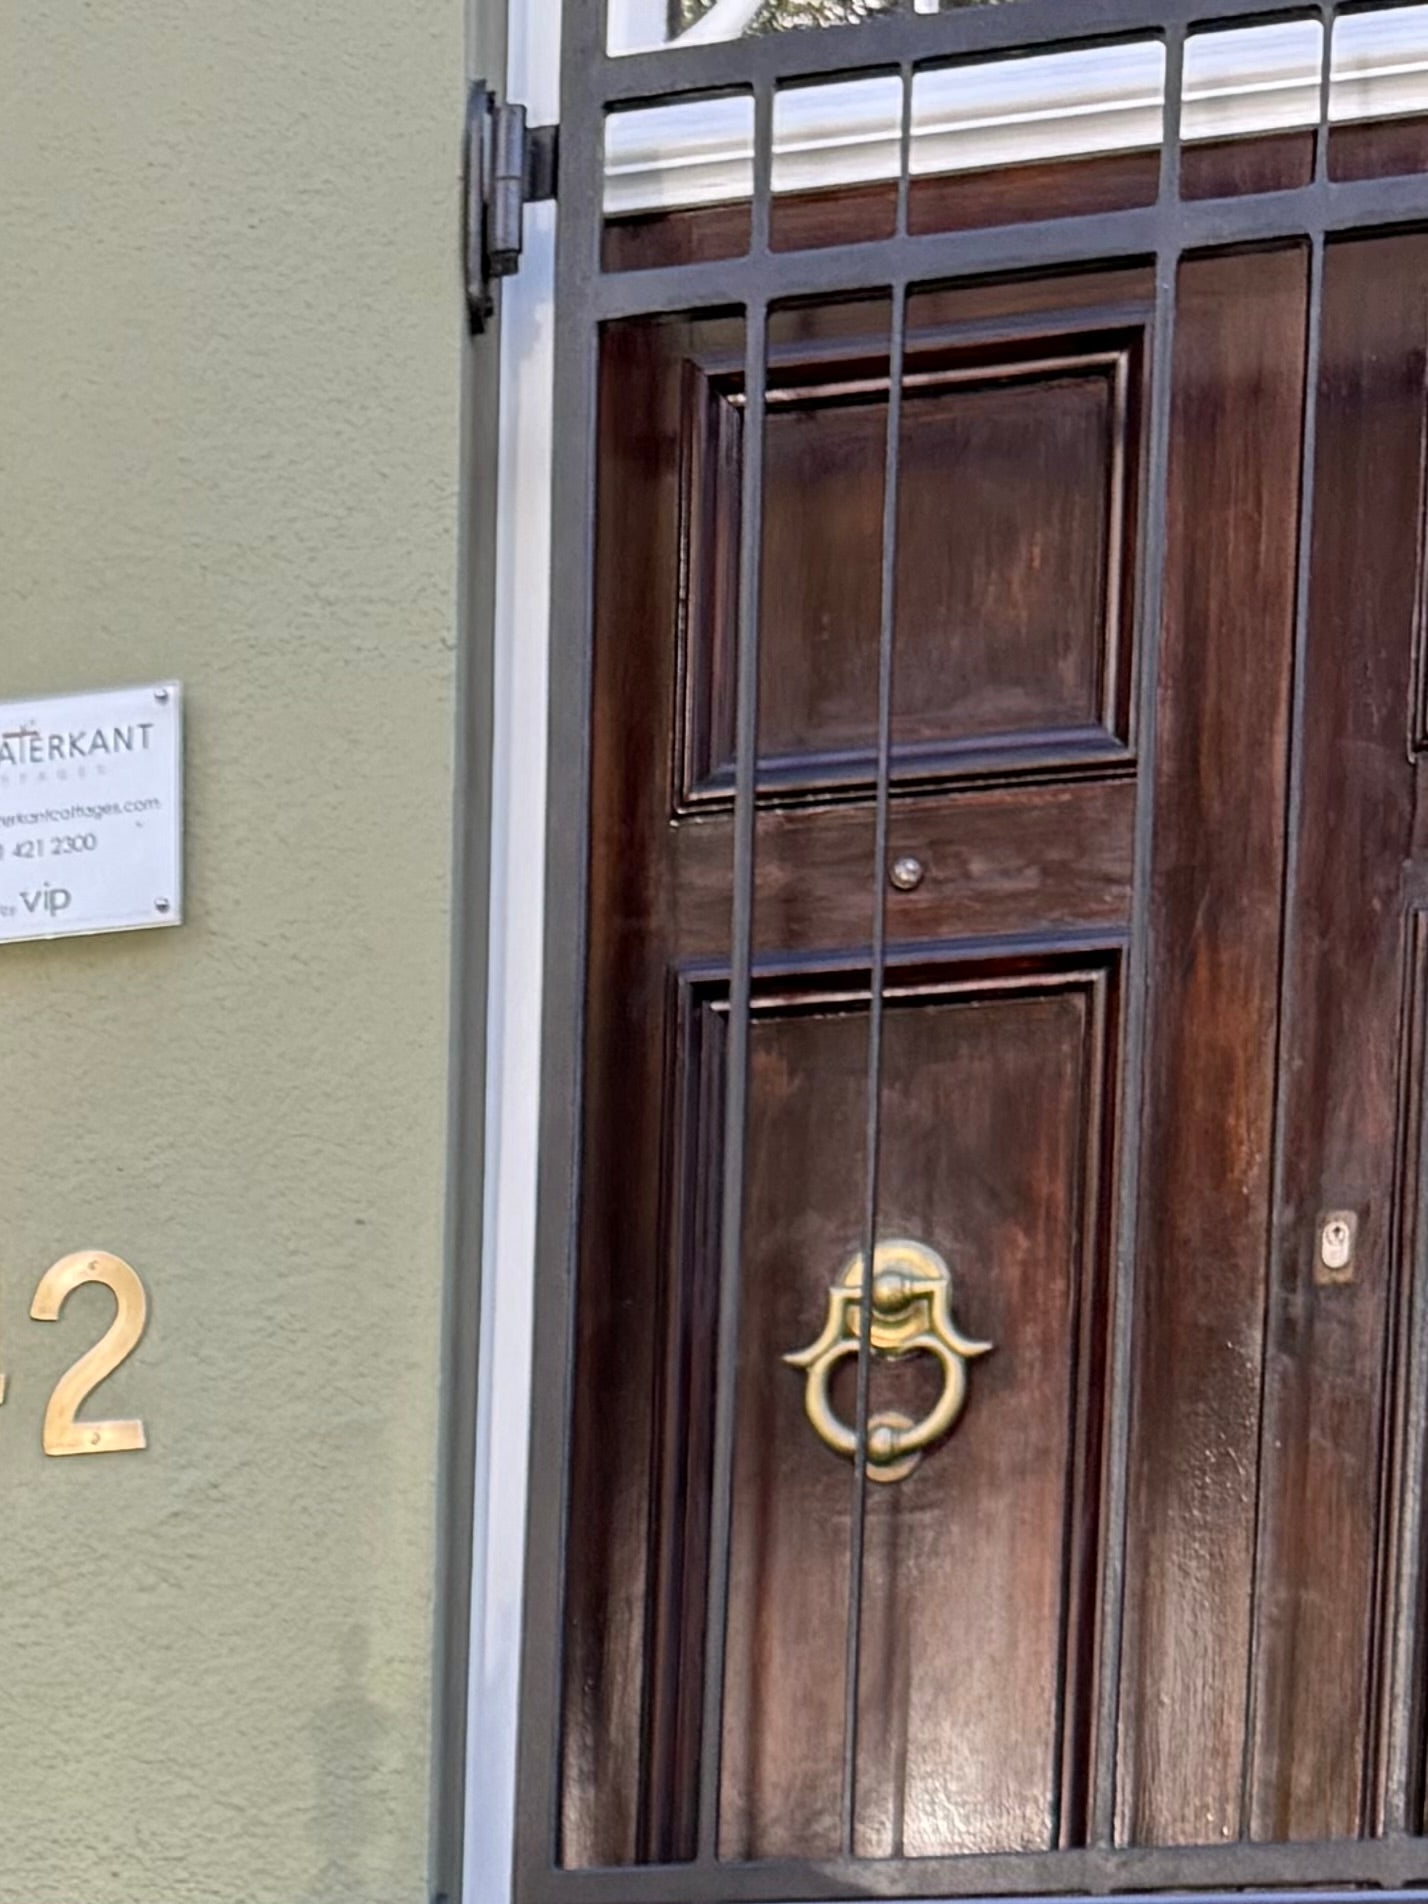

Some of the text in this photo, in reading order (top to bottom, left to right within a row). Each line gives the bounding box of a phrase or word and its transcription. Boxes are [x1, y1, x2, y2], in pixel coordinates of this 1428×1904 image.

[12, 839, 45, 859] 421
[50, 832, 97, 855] 2300
[19, 881, 72, 917] vip
